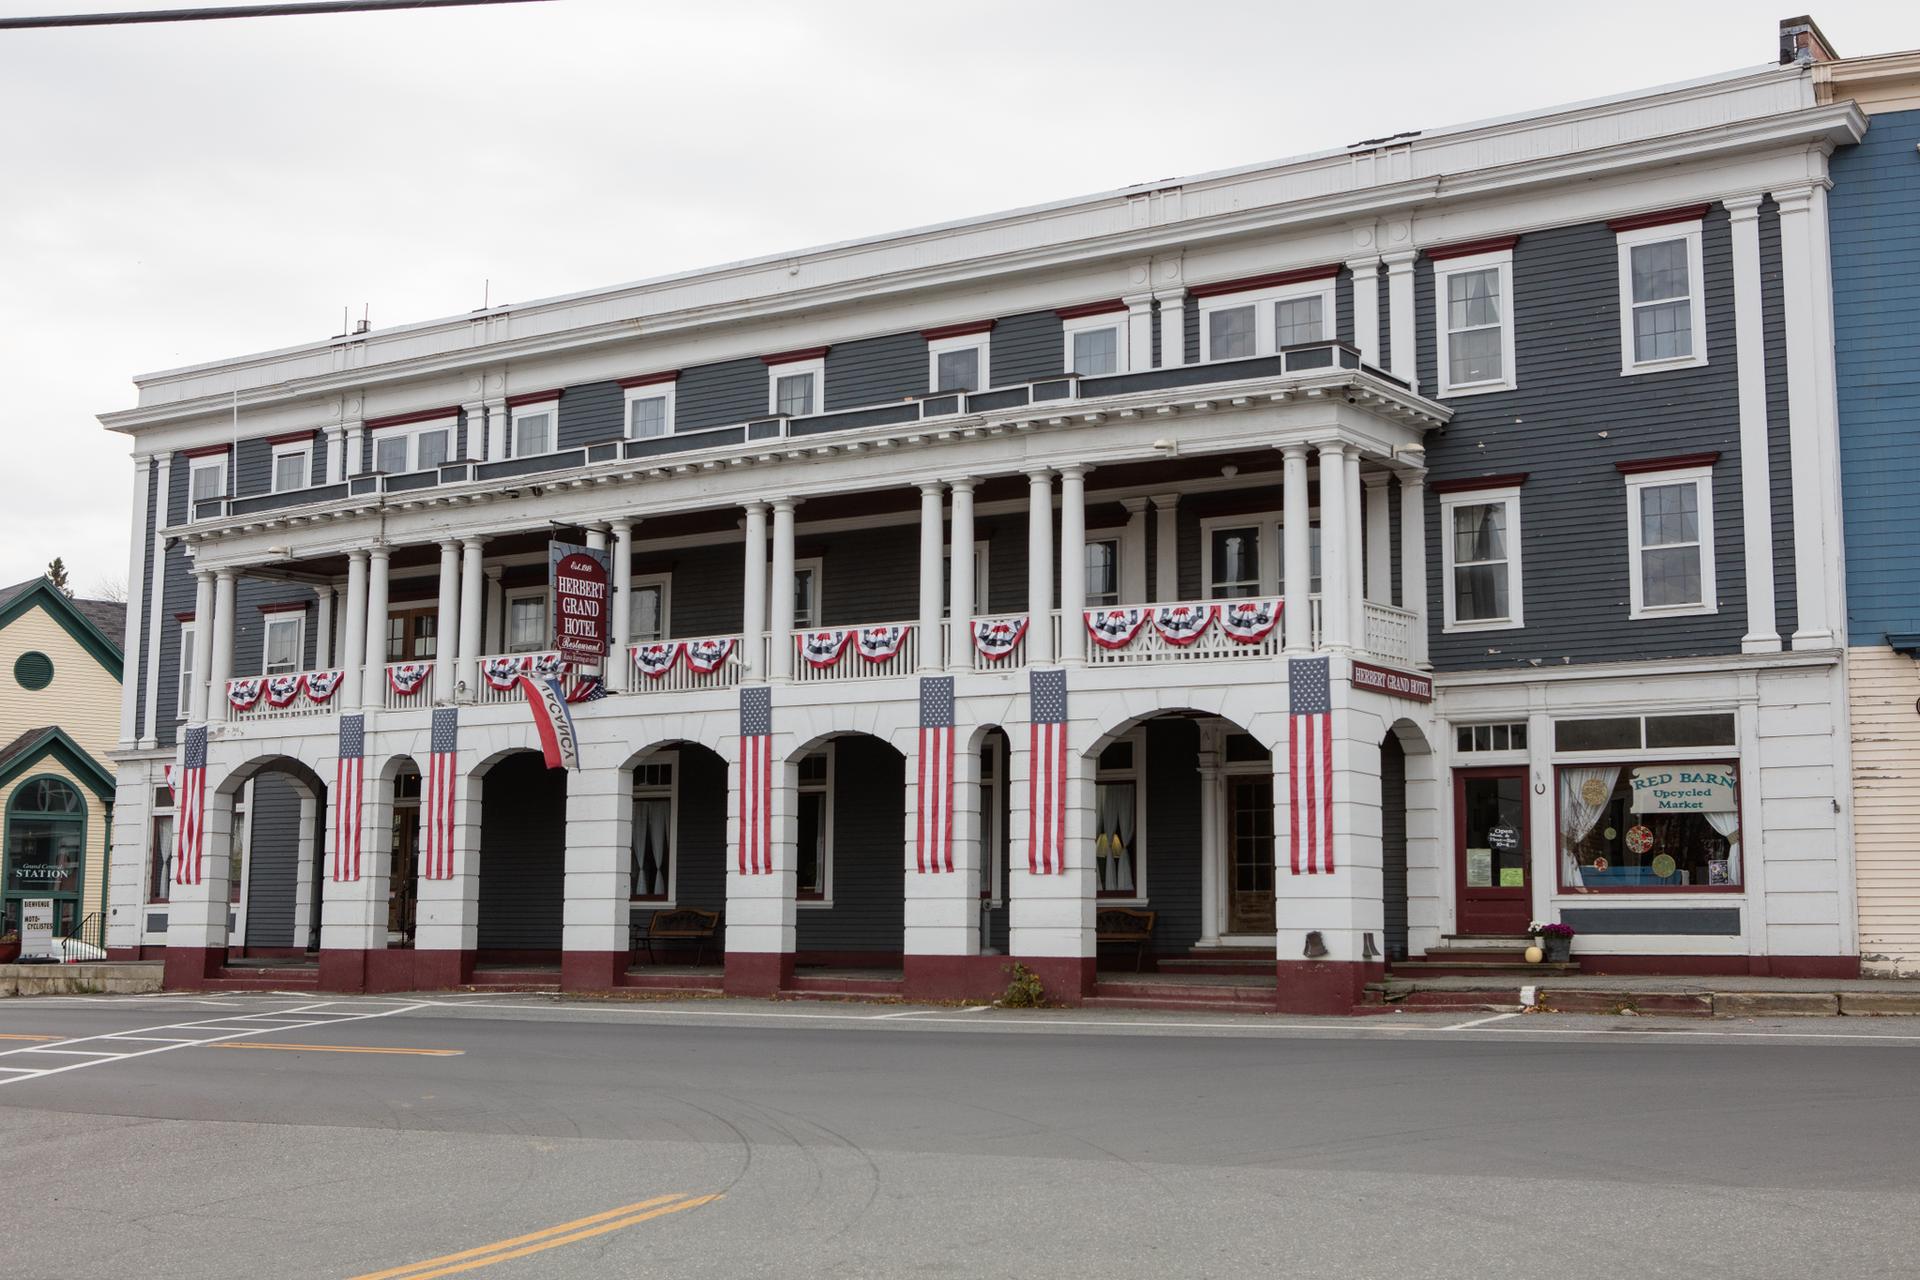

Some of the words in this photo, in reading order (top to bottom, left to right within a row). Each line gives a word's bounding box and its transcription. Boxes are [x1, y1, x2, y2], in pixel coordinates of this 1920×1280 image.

[558, 576, 605, 599] HERBERT
[562, 597, 600, 617] GRAND
[564, 618, 598, 638] HOTEL
[562, 637, 600, 651] Restaurant
[1355, 667, 1386, 688] HERBERT
[1387, 674, 1410, 692] GRAND
[1410, 680, 1430, 697] HOTEL
[1633, 773, 1673, 790] RED
[1680, 773, 1736, 790] BARN
[1653, 788, 1712, 799] Upcycled
[1658, 801, 1703, 809] Market
[16, 870, 68, 878] STATION
